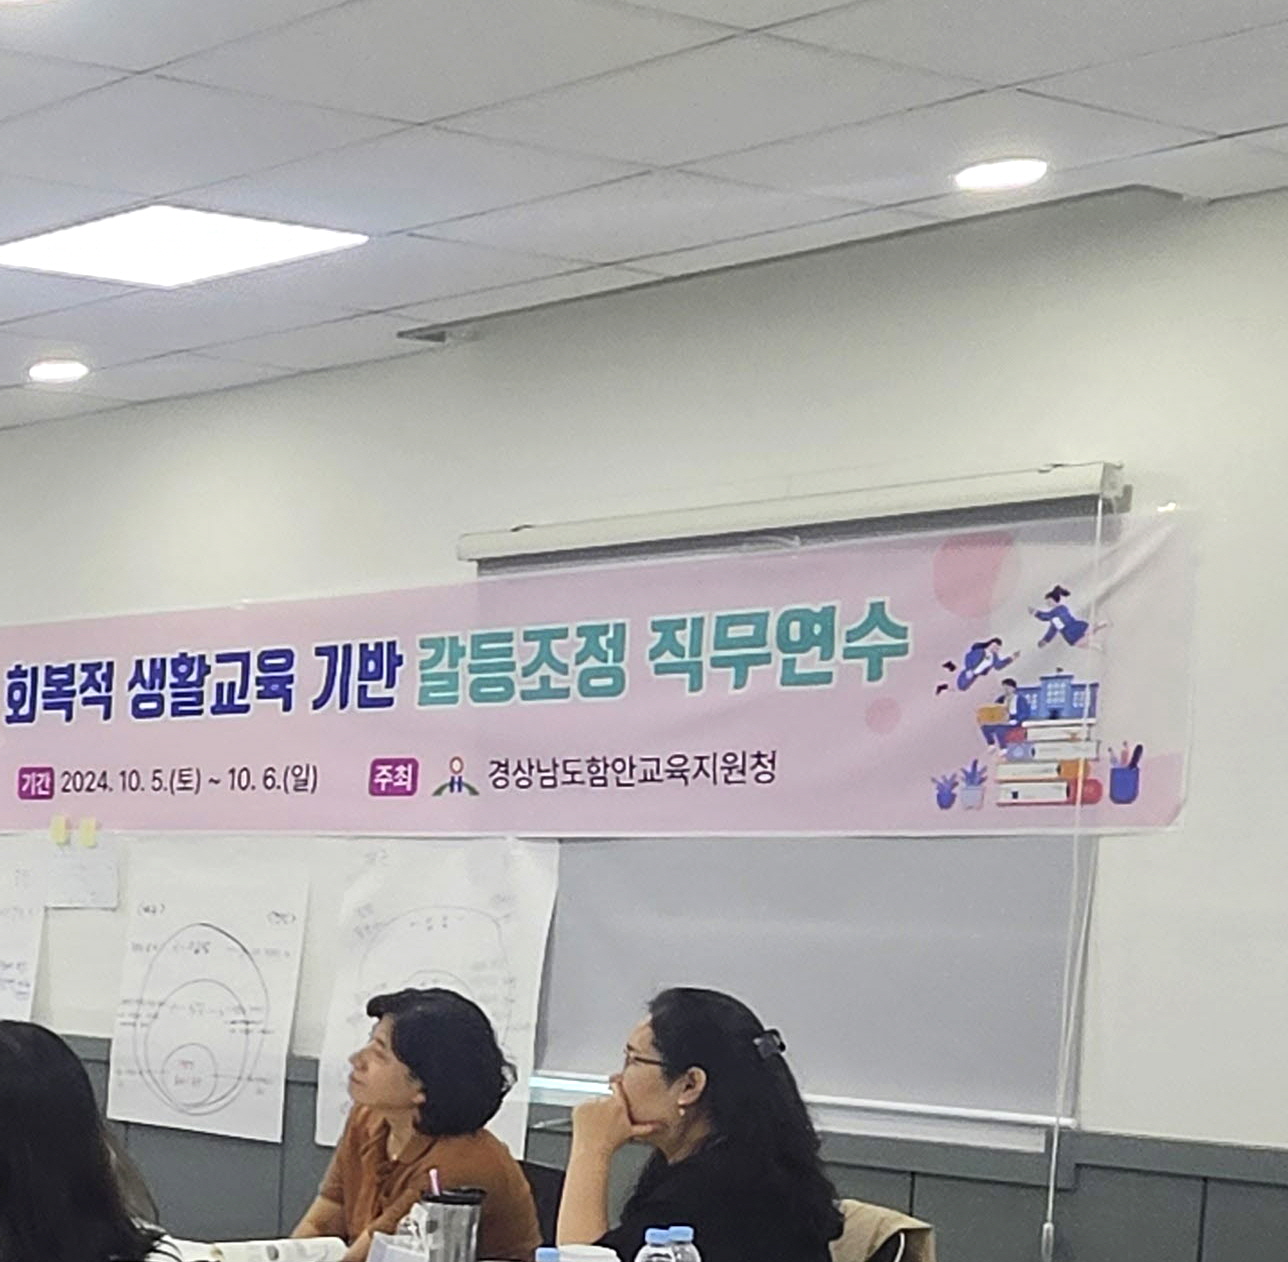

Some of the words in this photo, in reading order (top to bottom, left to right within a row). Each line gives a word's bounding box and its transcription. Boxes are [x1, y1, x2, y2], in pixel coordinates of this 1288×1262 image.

[4, 660, 115, 725] 회복적
[127, 648, 295, 720] 생활교육
[311, 640, 403, 710] 기반
[417, 620, 626, 706] 갈등조정
[648, 600, 910, 692] 직무연수
[20, 773, 53, 797] 기간
[60, 769, 114, 794] 2024.
[121, 769, 144, 793] 10.
[149, 767, 202, 794] 5.(토)
[228, 767, 257, 791] 10.
[262, 764, 318, 794] 6.(일)
[372, 764, 414, 793] 주최
[487, 751, 777, 790] 경상남도함안교육지원청
